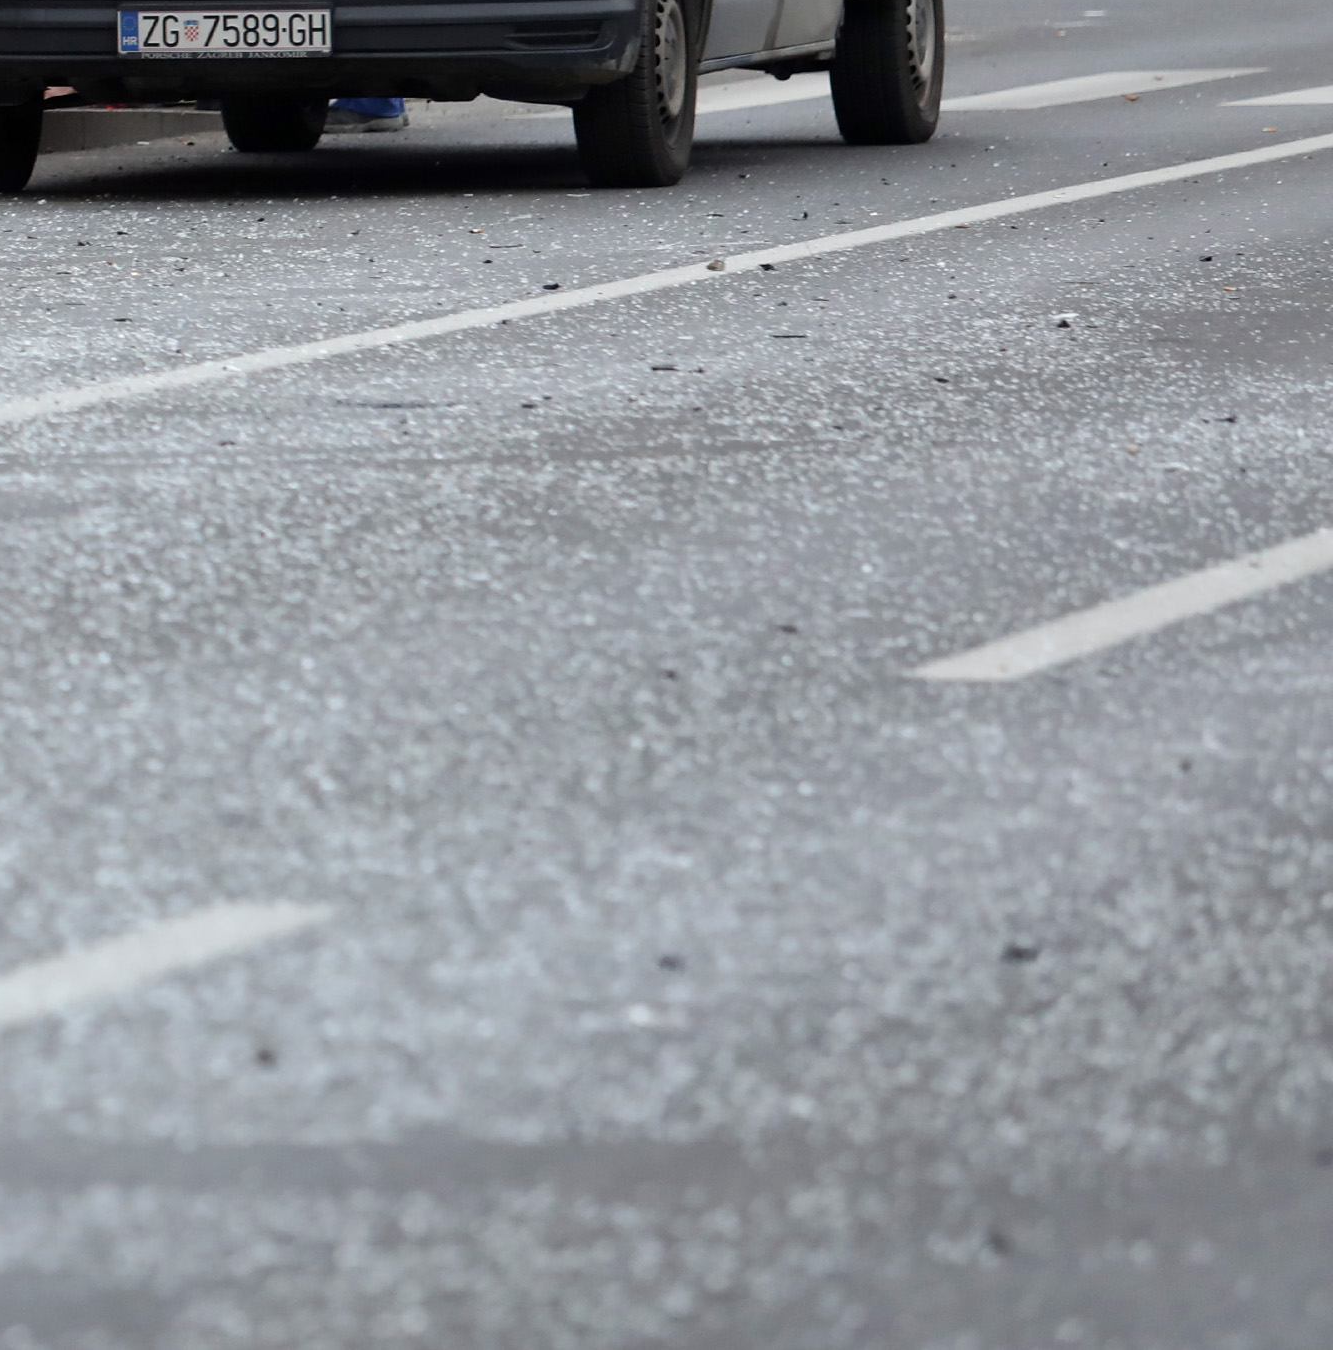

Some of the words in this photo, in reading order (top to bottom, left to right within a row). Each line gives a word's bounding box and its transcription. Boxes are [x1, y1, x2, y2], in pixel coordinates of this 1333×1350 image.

[142, 15, 180, 48] ZG
[122, 36, 138, 46] HR
[197, 51, 243, 59] ZAGREB
